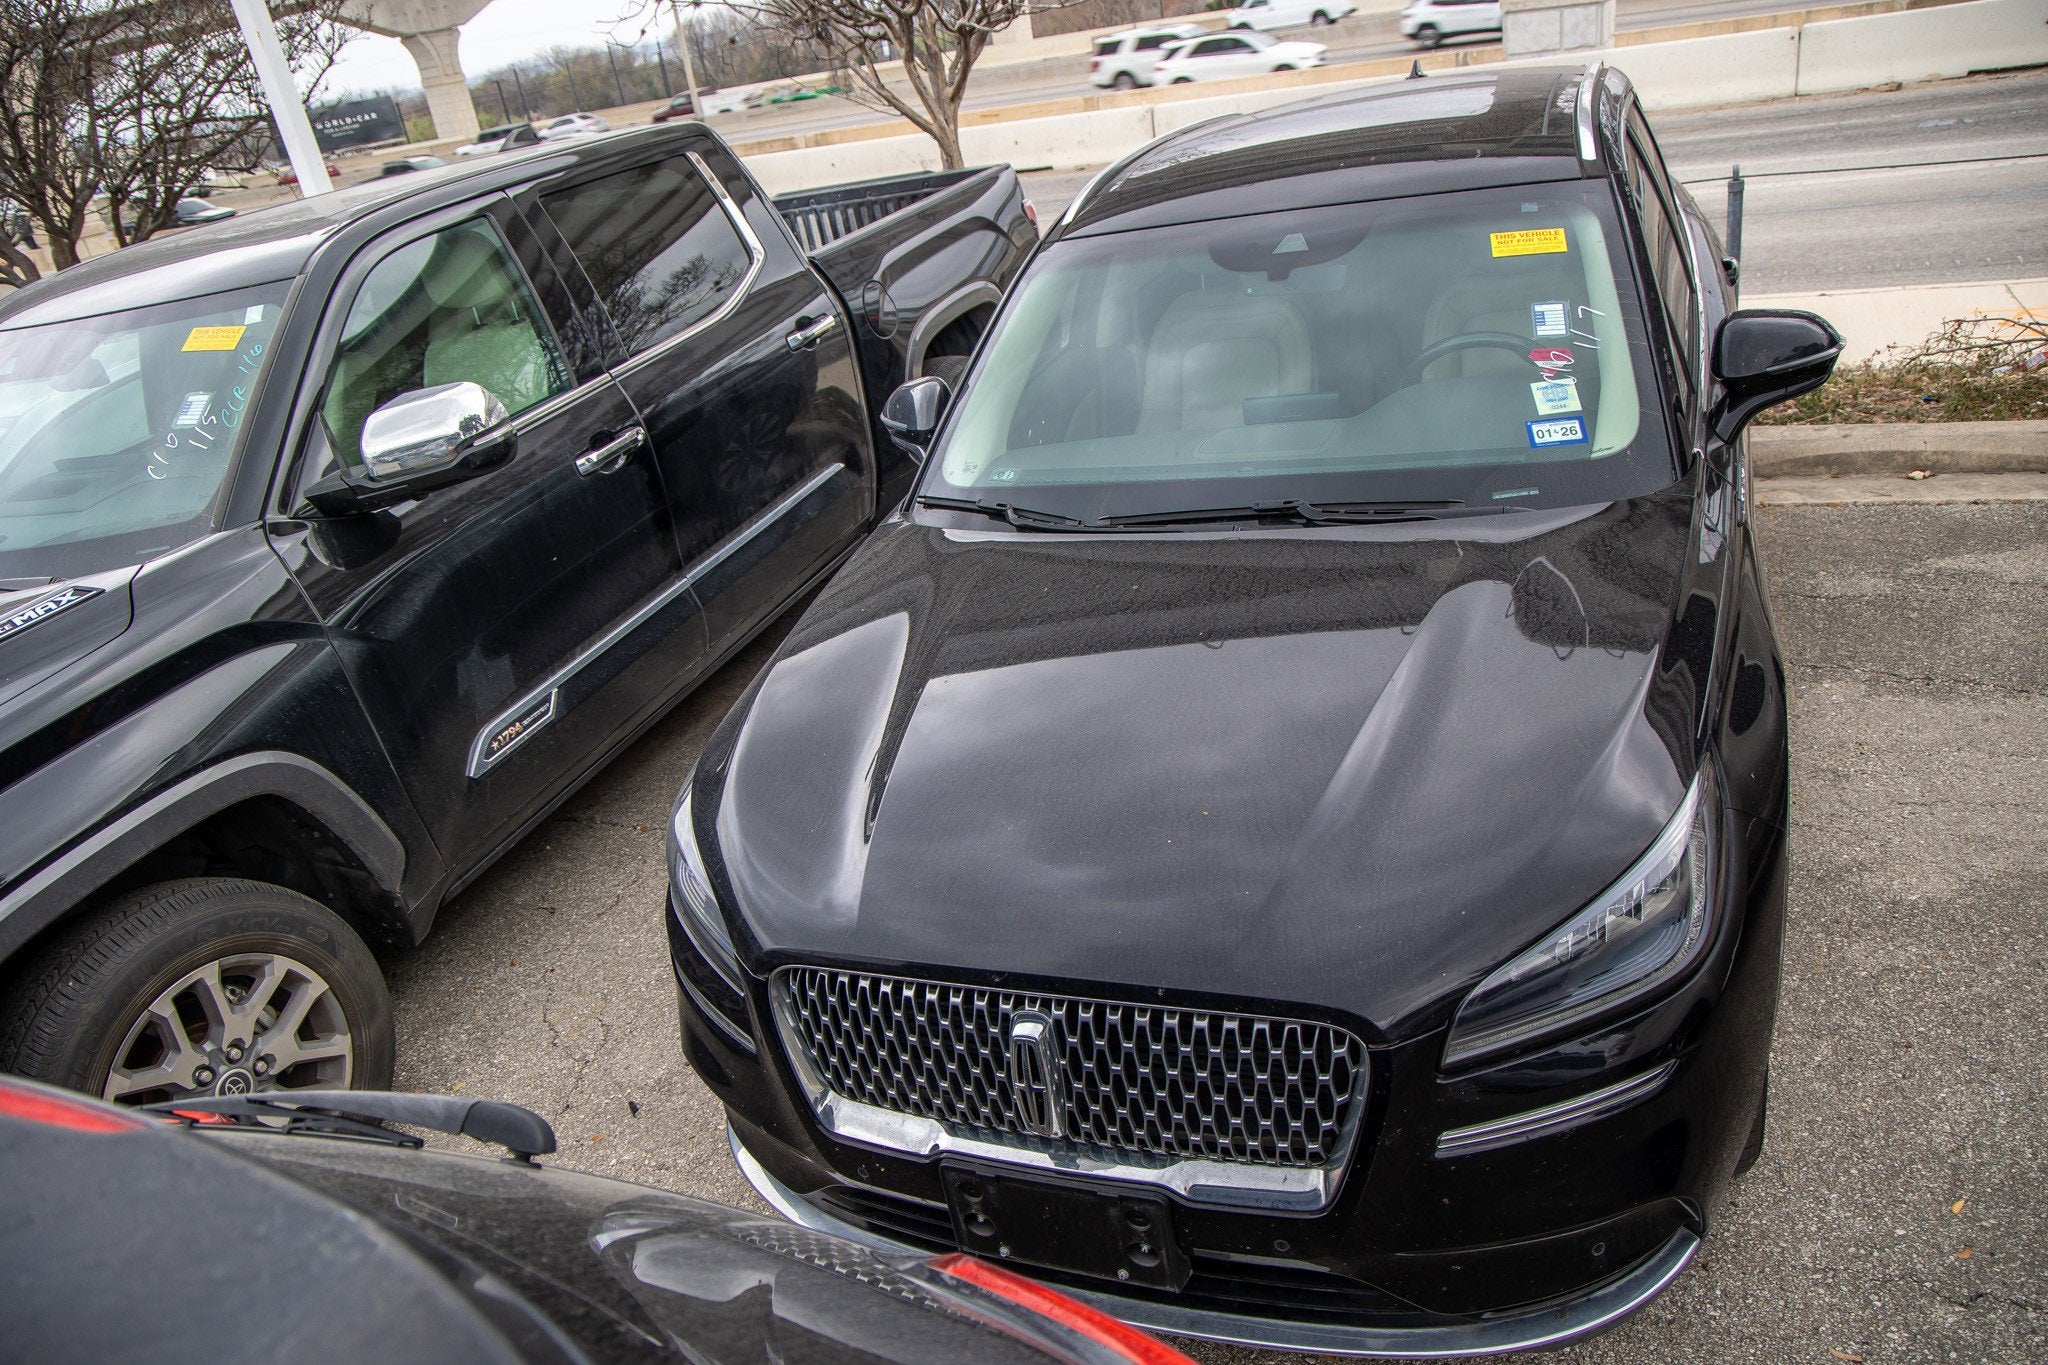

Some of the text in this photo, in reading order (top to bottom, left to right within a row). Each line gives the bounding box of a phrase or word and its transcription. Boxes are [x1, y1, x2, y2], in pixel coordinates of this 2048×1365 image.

[1519, 229, 1561, 238] VEHICLE
[1536, 425, 1578, 439] 01 26
[11, 588, 80, 627] MAX
[497, 722, 523, 746] 1794
